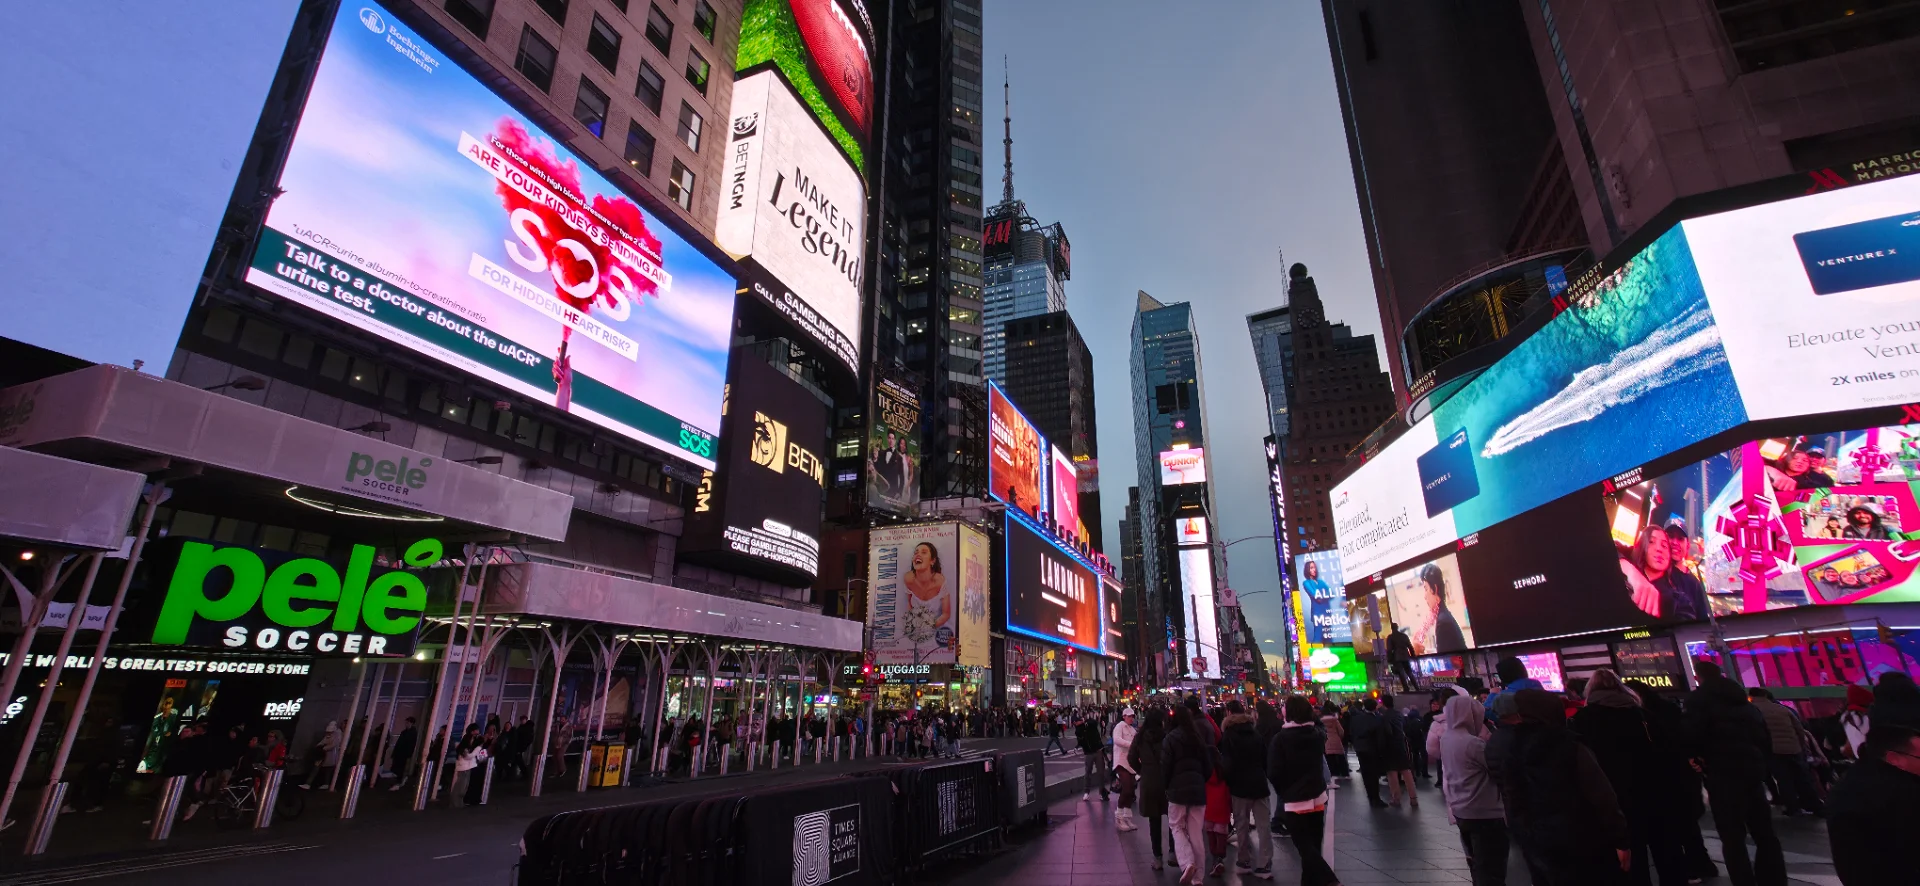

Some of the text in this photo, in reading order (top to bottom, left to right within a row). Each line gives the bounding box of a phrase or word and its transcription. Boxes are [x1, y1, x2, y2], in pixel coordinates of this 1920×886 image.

[386, 34, 433, 74] Ingelheim
[388, 25, 440, 68] Boehringer
[468, 143, 667, 284] ARE YOUR KIDNEYS SENDING AN
[491, 136, 662, 262] For those with high blood pressure or type 2 diabetes
[794, 165, 854, 244] MAKE IT
[504, 207, 633, 322] SOS
[1817, 250, 1885, 267] VENTURE
[276, 262, 376, 315] urine test.
[365, 260, 467, 314] albumin-to-creatinine
[1567, 261, 1603, 295] MARRIOTT
[1569, 273, 1602, 303] MARQUIS
[284, 240, 327, 273] Talk
[329, 263, 351, 283] to
[353, 276, 366, 291] a
[368, 282, 426, 316] doctor
[426, 310, 472, 339] about
[473, 328, 497, 349] the
[481, 263, 631, 353] FOR HIDDEN HEART RISK?
[754, 282, 775, 304] CALL
[827, 340, 837, 353] OR
[784, 291, 836, 340] GAMBLING
[1787, 327, 1866, 349] Elevate
[1830, 369, 1919, 386] 2X miles on
[878, 393, 892, 411] THE
[679, 429, 711, 457] SOS
[681, 422, 712, 442] DETECT THE
[345, 451, 433, 490] pelé
[1614, 467, 1643, 483] MARRIOTT
[1615, 474, 1642, 490] MARQUIS
[363, 478, 410, 496] SOCCER
[723, 530, 750, 545] PLEASE
[750, 538, 777, 553] GAMBLE
[1355, 506, 1409, 547] complicated
[731, 541, 749, 553] CALL
[878, 547, 898, 580] MIA!
[1040, 552, 1086, 605] LANDMAN
[151, 537, 444, 645] pelé
[1513, 573, 1547, 589] SEPHORA
[874, 583, 897, 640] MAMMA
[222, 625, 388, 655] SOCCER
[1623, 630, 1651, 640] SEPHORA
[120, 658, 206, 672] GREATEST
[206, 661, 266, 674] SOCCER
[266, 663, 310, 675] STORE
[880, 664, 930, 675] LUGGAGE
[263, 697, 304, 717] pelé
[831, 833, 857, 852] SQUARE
[834, 819, 855, 836] TIMES
